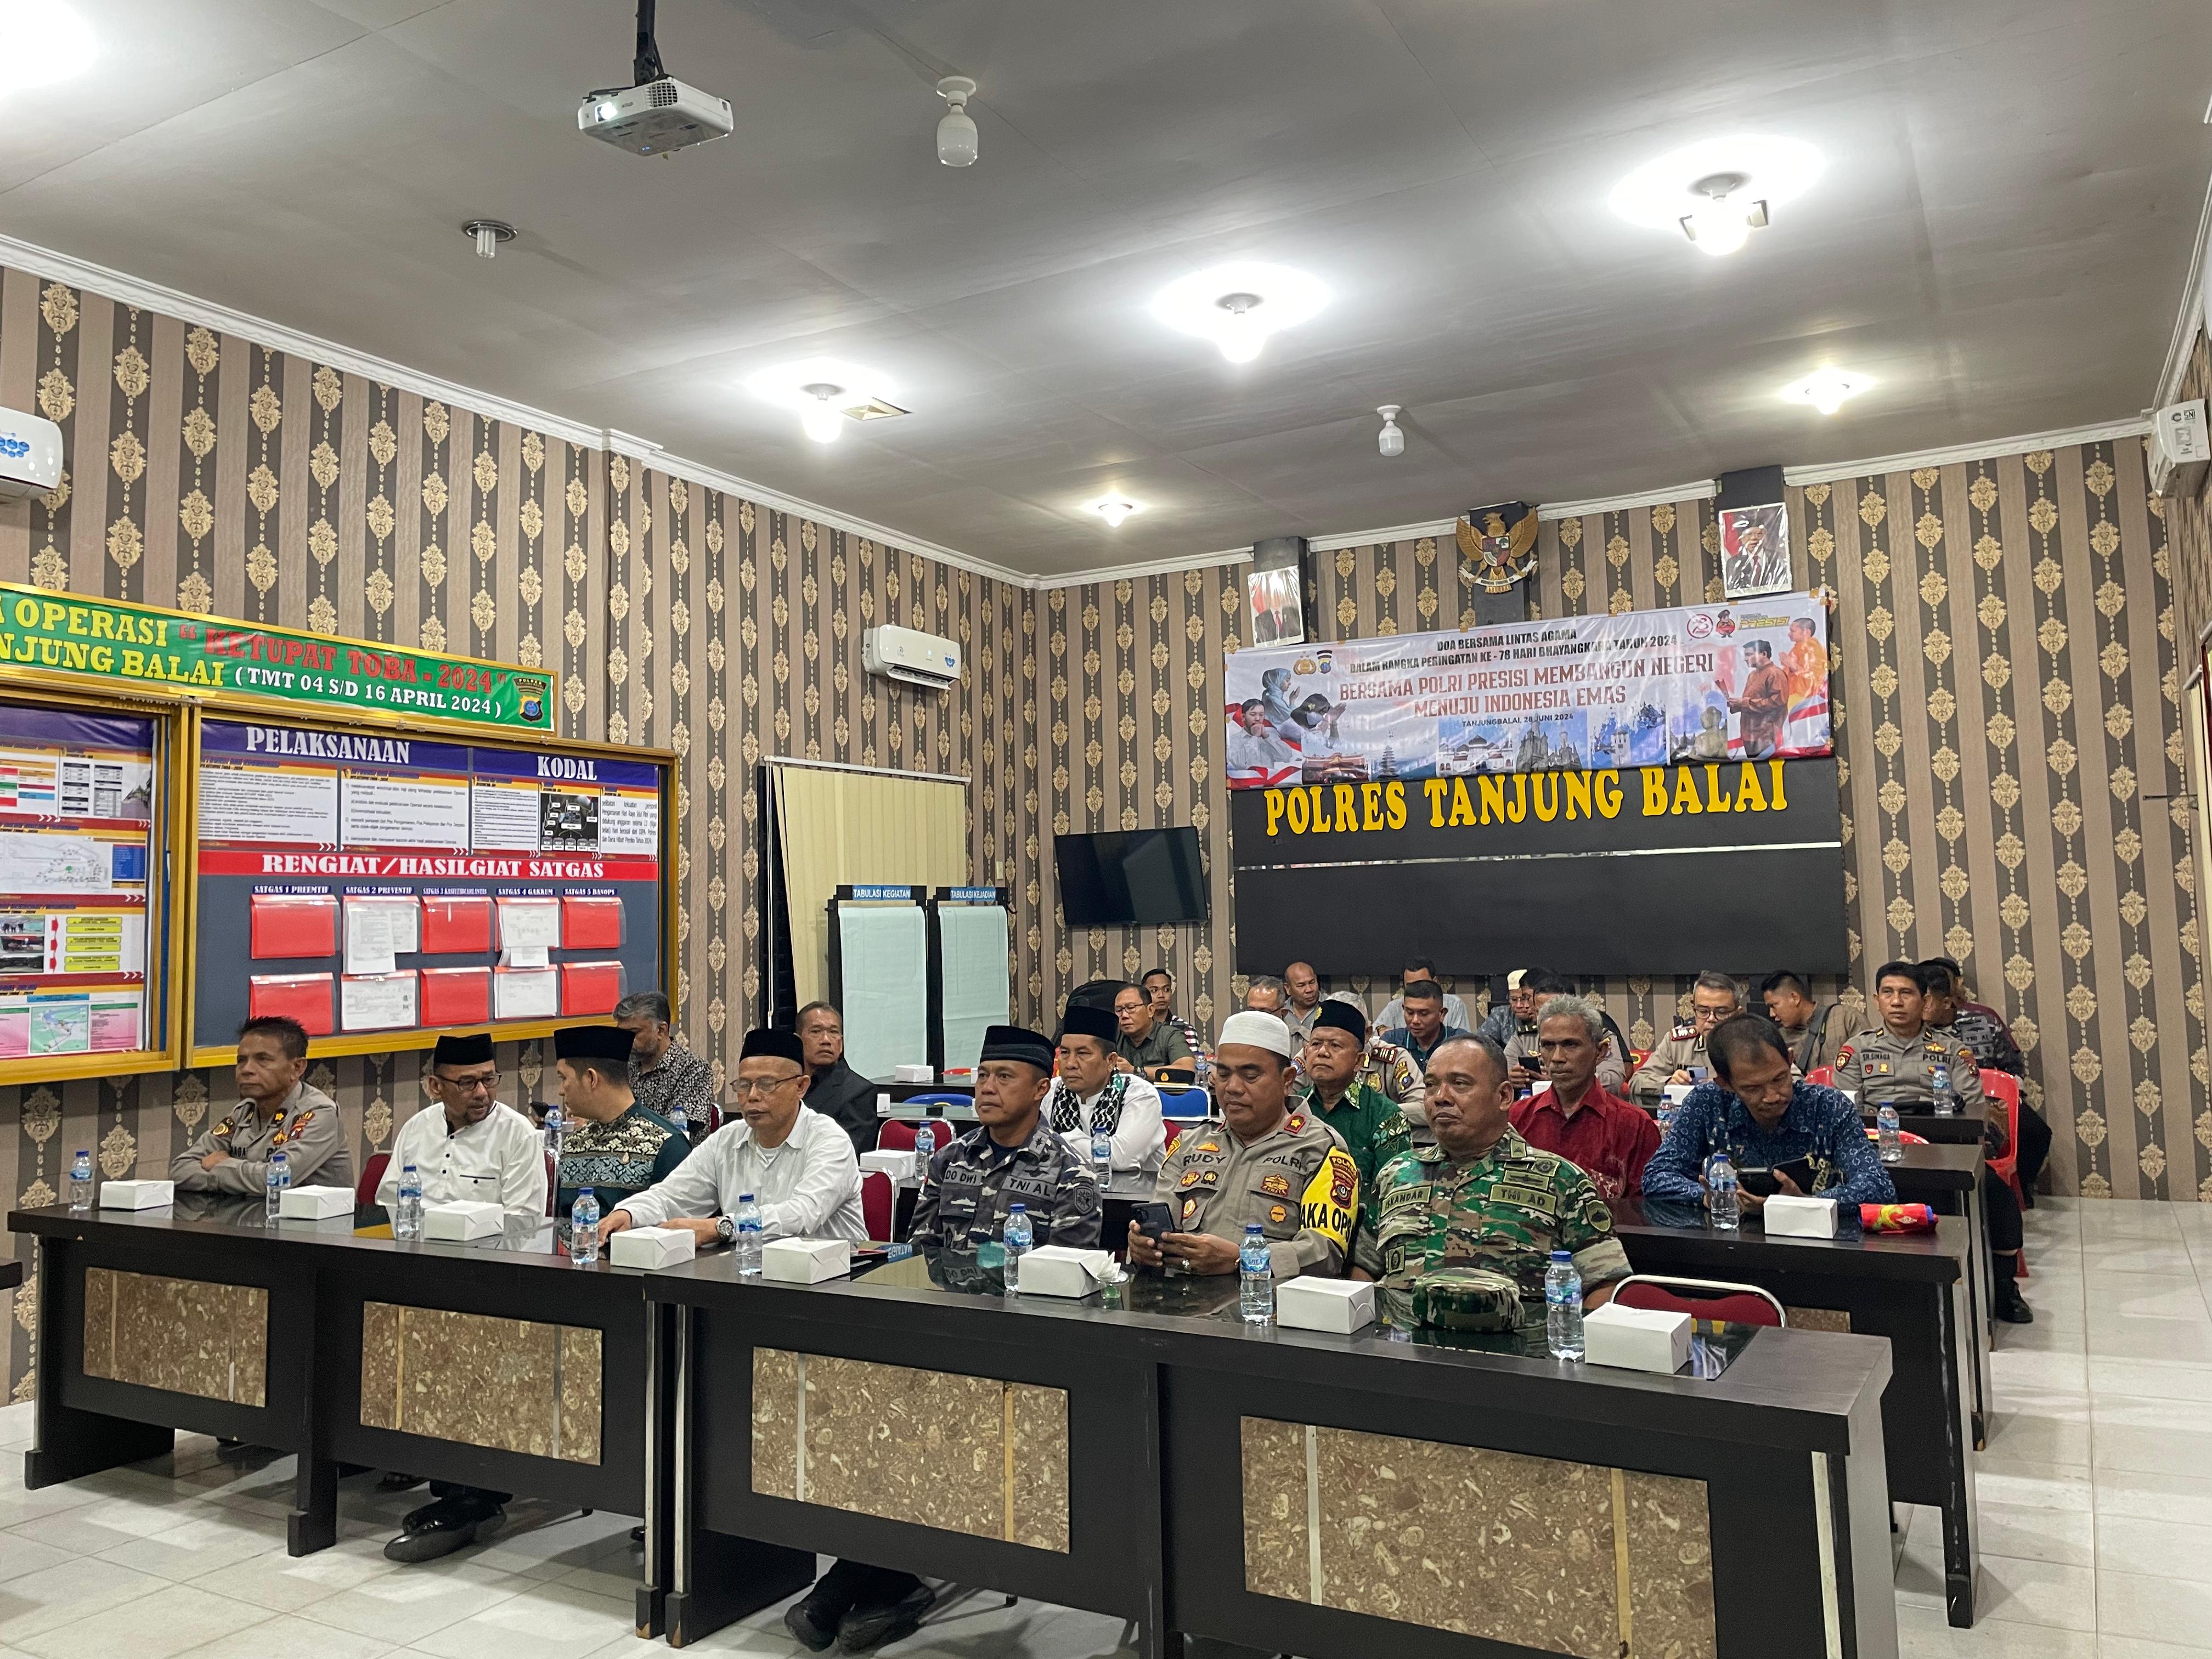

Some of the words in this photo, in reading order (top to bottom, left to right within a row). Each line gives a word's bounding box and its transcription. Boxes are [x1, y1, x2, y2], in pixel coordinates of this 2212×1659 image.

[15, 599, 167, 647] OPERASI
[205, 628, 337, 671] KETUPAT
[347, 650, 417, 683] TOBA
[437, 664, 492, 693] 2024
[1437, 640, 1456, 651] DOA
[1458, 636, 1504, 650] BERSAMA
[1506, 632, 1539, 644] LINTAS
[1541, 629, 1576, 642] AGAMA
[1350, 662, 1380, 673] DALAM
[1383, 658, 1419, 670] RANGKA
[1421, 653, 1478, 668] PERINGATAN
[1480, 651, 1491, 662] KE
[1499, 650, 1510, 661] 78
[1513, 647, 1536, 659] HARI
[1539, 640, 1612, 657] BHAYANGKARA
[1614, 636, 1647, 650] TAHUN
[1650, 635, 1677, 647] 2024
[121, 649, 224, 687] BALAI
[300, 675, 323, 693] 04
[328, 678, 358, 697] S/D
[365, 684, 385, 701] 16
[390, 687, 447, 709] APRIL
[1340, 677, 1413, 701] BERSAMA
[1418, 674, 1462, 694] POLRI
[1468, 669, 1528, 690] PRESISI
[1534, 658, 1645, 686] MEMBANGUN
[1651, 653, 1713, 676] NEGERI
[1414, 696, 1479, 718] MENUJU
[1485, 690, 1571, 713] INDONESIA
[1577, 685, 1626, 706] EMAS
[246, 726, 409, 764] PELAKSANAAN
[537, 756, 598, 781] KODAL
[1263, 781, 1408, 836] POLRES
[1424, 770, 1624, 827] TANJUNG
[1640, 758, 1788, 816] BALAI
[262, 854, 521, 877] RENGIAT/HASILGIAT
[529, 861, 604, 878] SATGAS
[255, 885, 283, 894] SATGAS
[853, 889, 881, 898] TABULASI
[883, 889, 911, 898] KEGIATAN
[951, 890, 973, 899] TABULASI
[974, 890, 995, 899] KEJADIAN
[1923, 1054, 1951, 1064] POLRI
[1183, 1154, 1227, 1166] RUDY
[1262, 1155, 1301, 1171] POLRI
[960, 1173, 977, 1184] DWI
[1009, 1179, 1030, 1191] TNI
[1033, 1184, 1050, 1196] AL
[1385, 1190, 1423, 1209] ISKANDAR
[1500, 1188, 1520, 1200] TNI
[1528, 1195, 1545, 1206] AD
